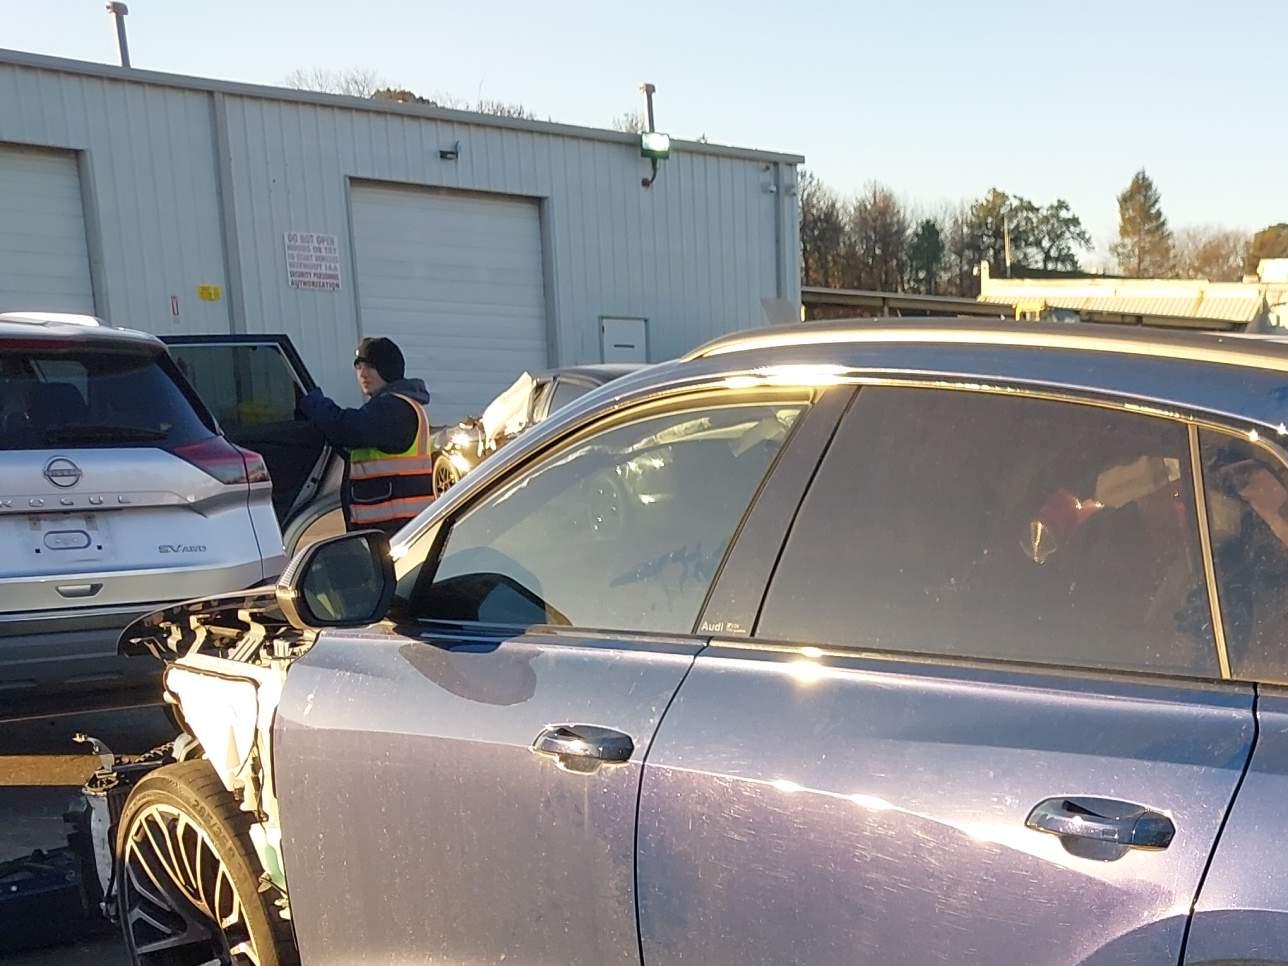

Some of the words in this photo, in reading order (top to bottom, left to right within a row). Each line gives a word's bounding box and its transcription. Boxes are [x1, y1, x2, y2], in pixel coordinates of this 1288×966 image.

[287, 233, 298, 243] DO
[300, 234, 314, 244] NOT
[316, 235, 335, 246] OPEN
[291, 279, 340, 289] AUTHORIZATION
[701, 621, 724, 632] Audi
